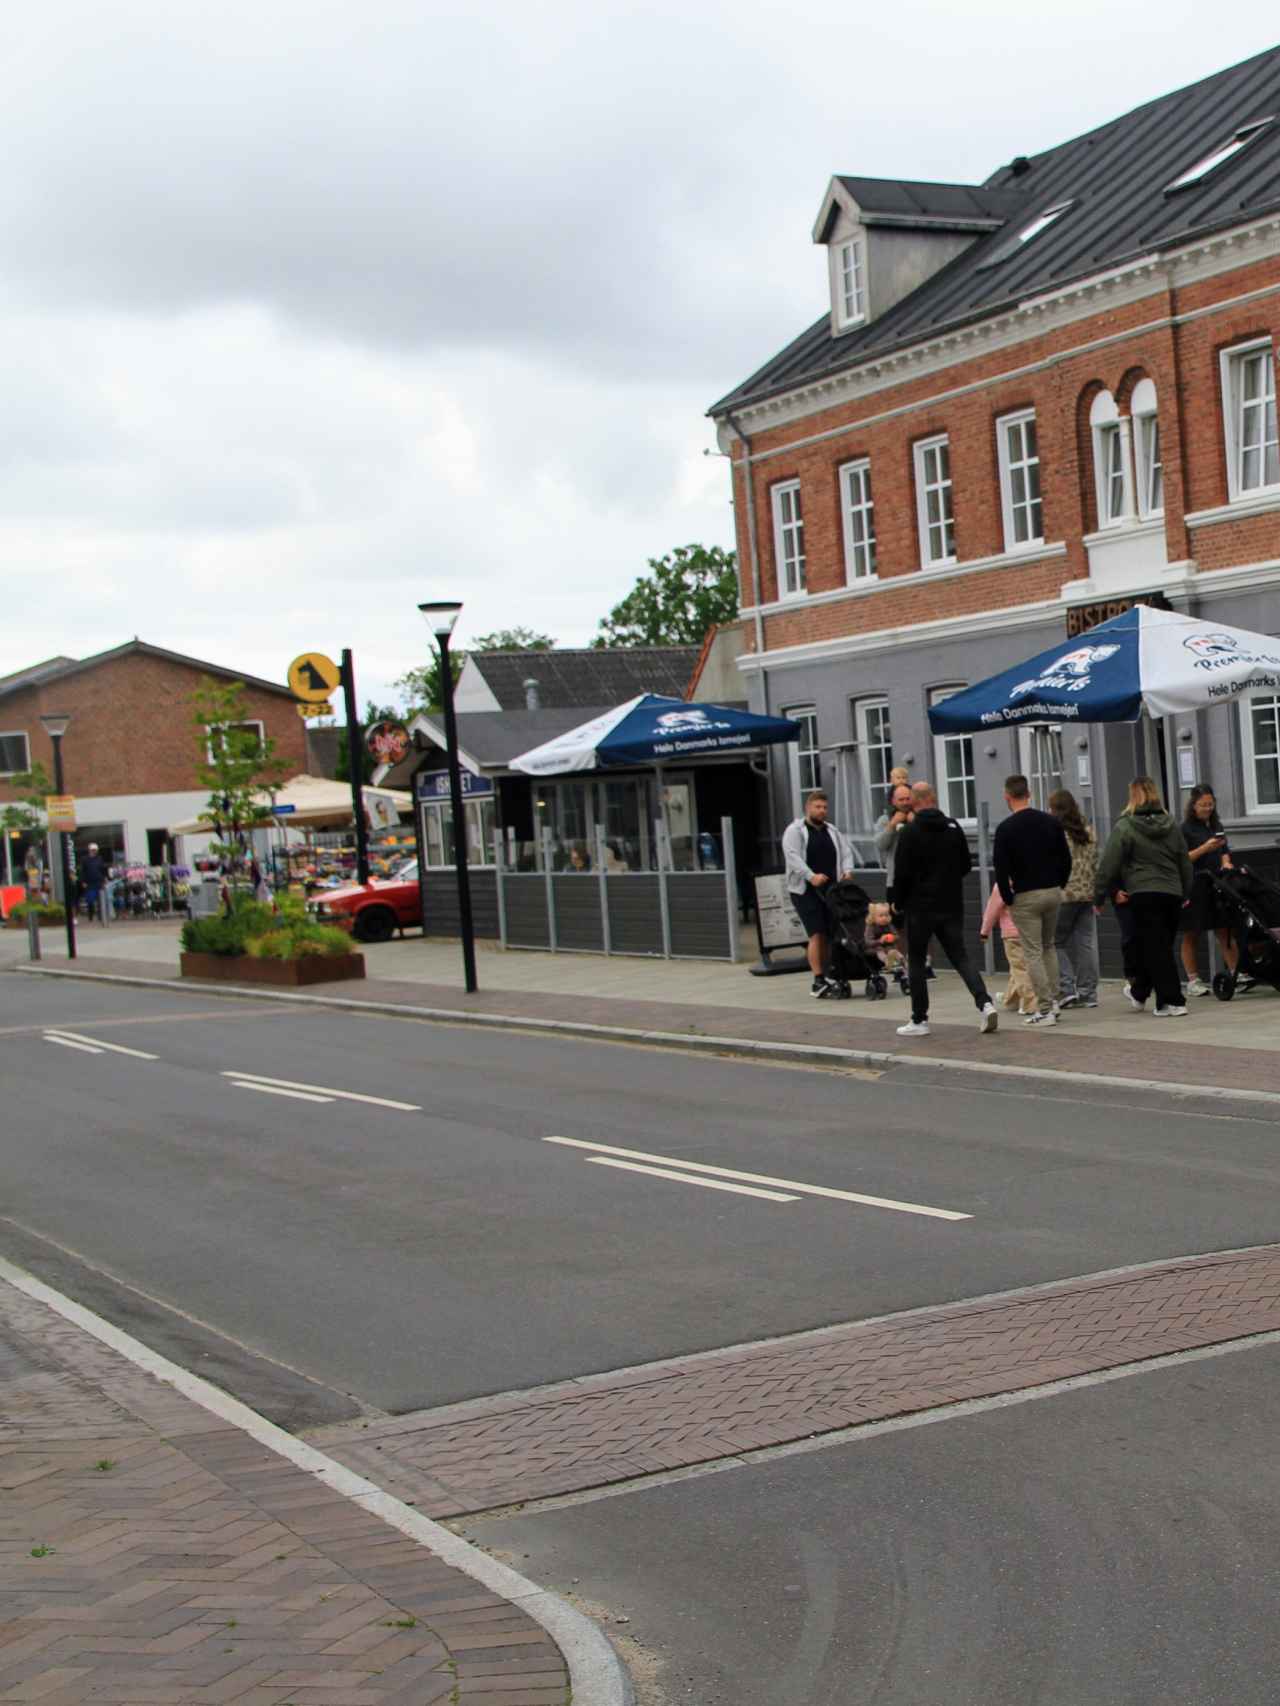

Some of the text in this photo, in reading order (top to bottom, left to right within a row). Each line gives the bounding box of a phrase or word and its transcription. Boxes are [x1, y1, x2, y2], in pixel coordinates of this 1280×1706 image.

[1208, 684, 1229, 697] Hele
[1230, 674, 1275, 693] Danmarks
[981, 711, 1003, 724] Hele
